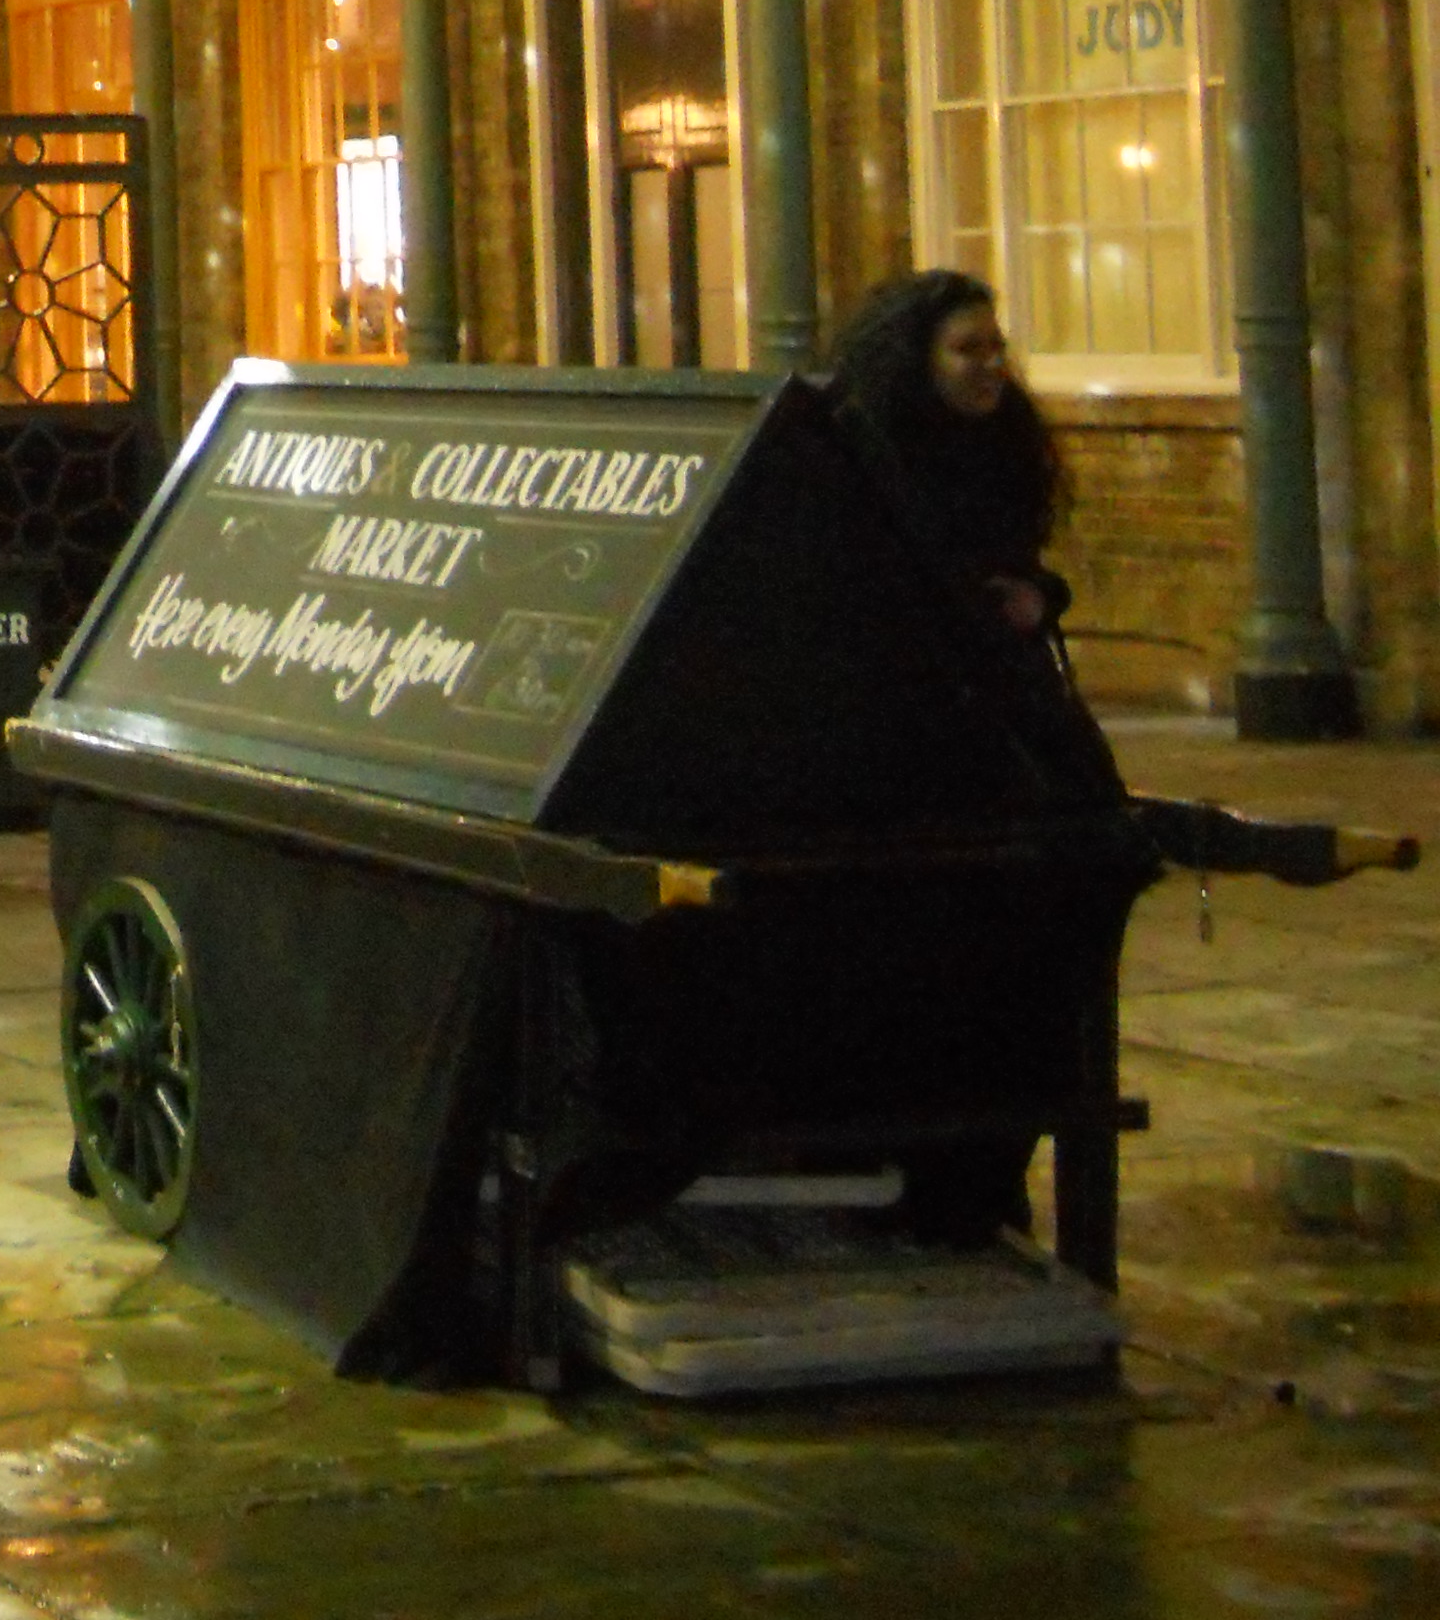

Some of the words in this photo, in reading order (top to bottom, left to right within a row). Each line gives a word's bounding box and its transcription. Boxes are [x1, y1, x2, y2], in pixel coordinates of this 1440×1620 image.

[215, 429, 387, 496] ANTIQUES
[410, 442, 704, 517] COLLECTABLES
[308, 514, 483, 588] MARKET
[129, 572, 206, 660] Here
[192, 601, 274, 685] every
[263, 592, 391, 703] Monday
